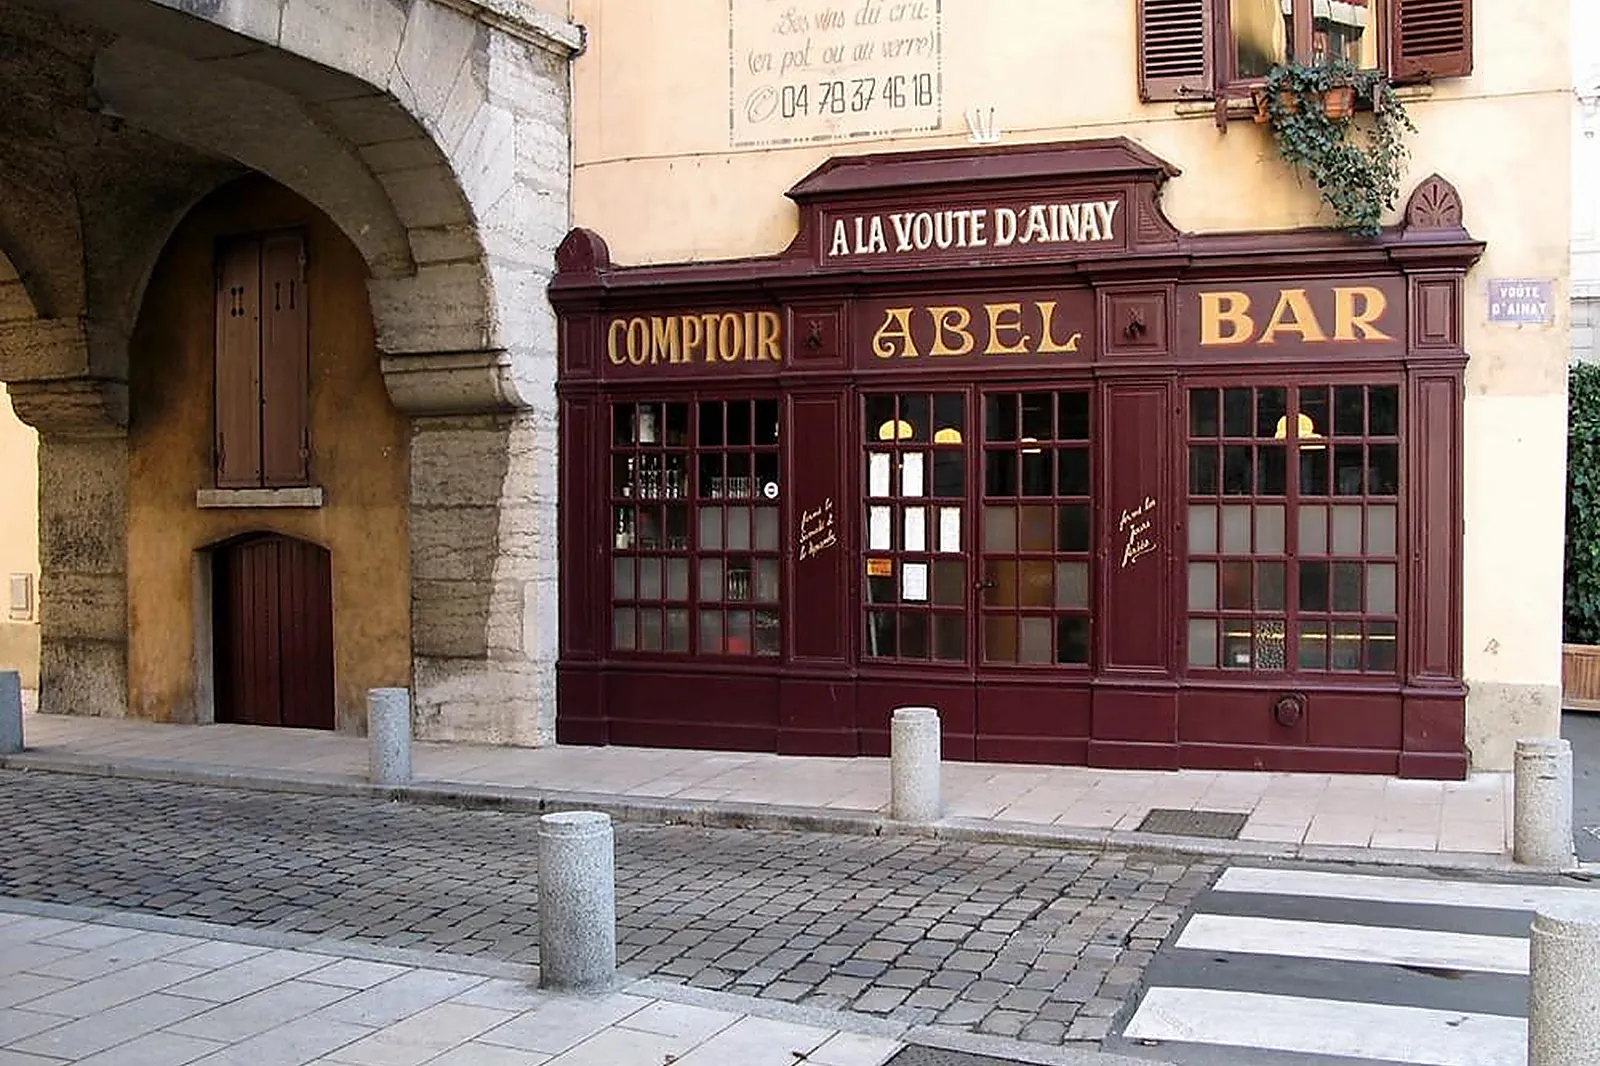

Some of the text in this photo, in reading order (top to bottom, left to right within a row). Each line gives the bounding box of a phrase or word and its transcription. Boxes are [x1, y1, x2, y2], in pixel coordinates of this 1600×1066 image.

[855, 0, 882, 25] du
[780, 38, 812, 75] pot
[823, 45, 845, 64] ou
[854, 43, 875, 62] au
[782, 73, 932, 118] 04 78 37 46 18
[829, 199, 1120, 257] A LA VOUTE D'AINAY
[871, 301, 1083, 359] ABEL
[1198, 287, 1392, 346] BAR
[1491, 302, 1547, 316] D'AINAY
[606, 311, 783, 367] COMPTOIR
